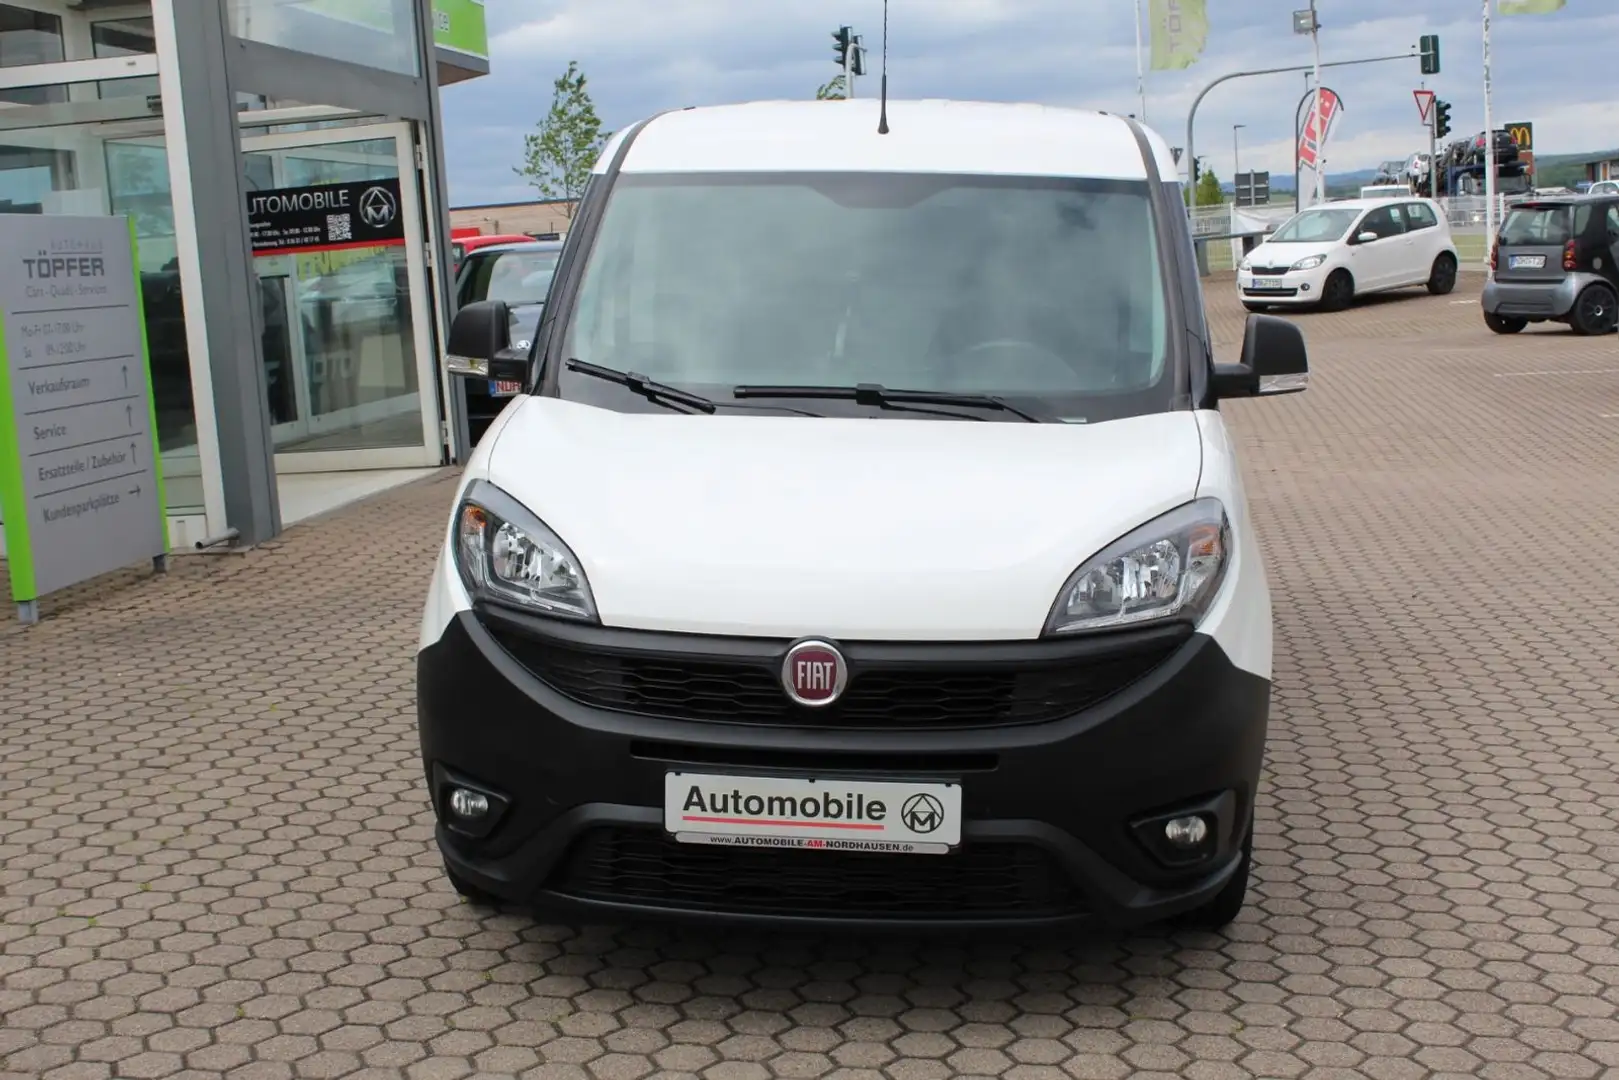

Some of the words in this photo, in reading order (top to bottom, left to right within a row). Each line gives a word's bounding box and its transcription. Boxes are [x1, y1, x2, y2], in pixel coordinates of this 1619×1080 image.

[249, 189, 350, 215] UTOMOBILE
[22, 249, 105, 279] TÖPFER
[27, 377, 90, 396] Verkaufsraum
[33, 424, 67, 440] Service
[38, 458, 85, 481] Ersatzteile
[90, 450, 126, 469] Zubehör
[43, 494, 120, 523] Kundenparkplätze
[796, 660, 834, 690] FIAT
[682, 785, 887, 821] Automobile
[709, 834, 914, 852] www.AUTOMOBILE-AM-NORDHAUSEN.de
